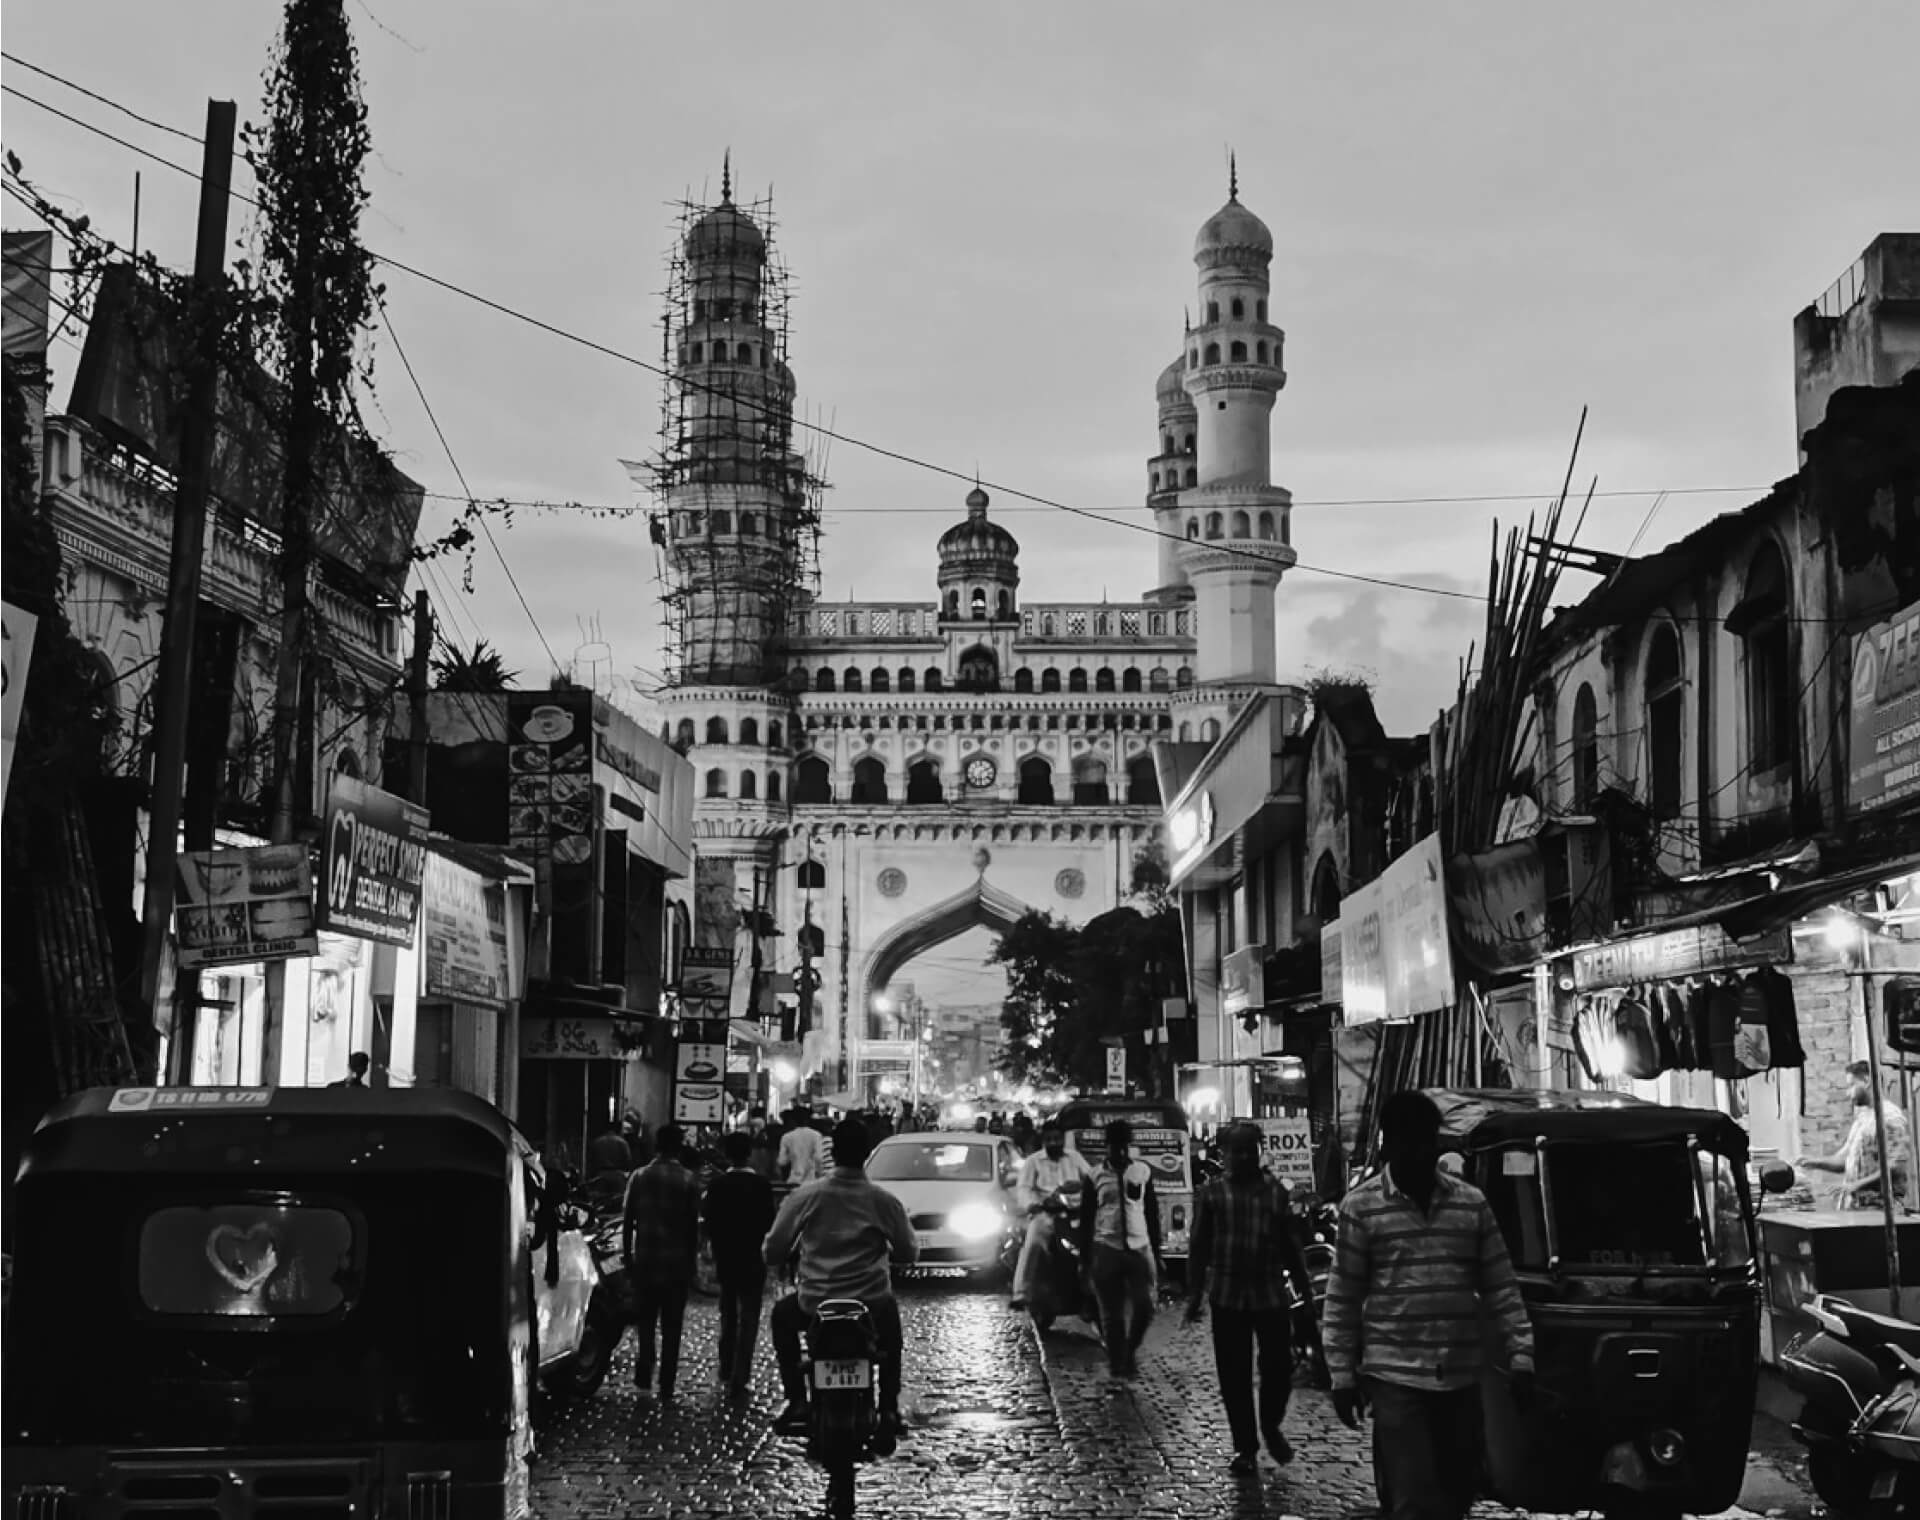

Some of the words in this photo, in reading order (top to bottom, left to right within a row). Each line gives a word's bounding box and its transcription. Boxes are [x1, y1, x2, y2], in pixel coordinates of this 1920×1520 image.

[354, 822, 399, 876] PERFECT
[397, 839, 426, 886] SMILE
[355, 876, 388, 914] DENTAL
[388, 886, 414, 920] CLINIC
[202, 944, 249, 959] DENTAL
[253, 940, 297, 954] CLINIC
[1259, 1133, 1308, 1151] EROX
